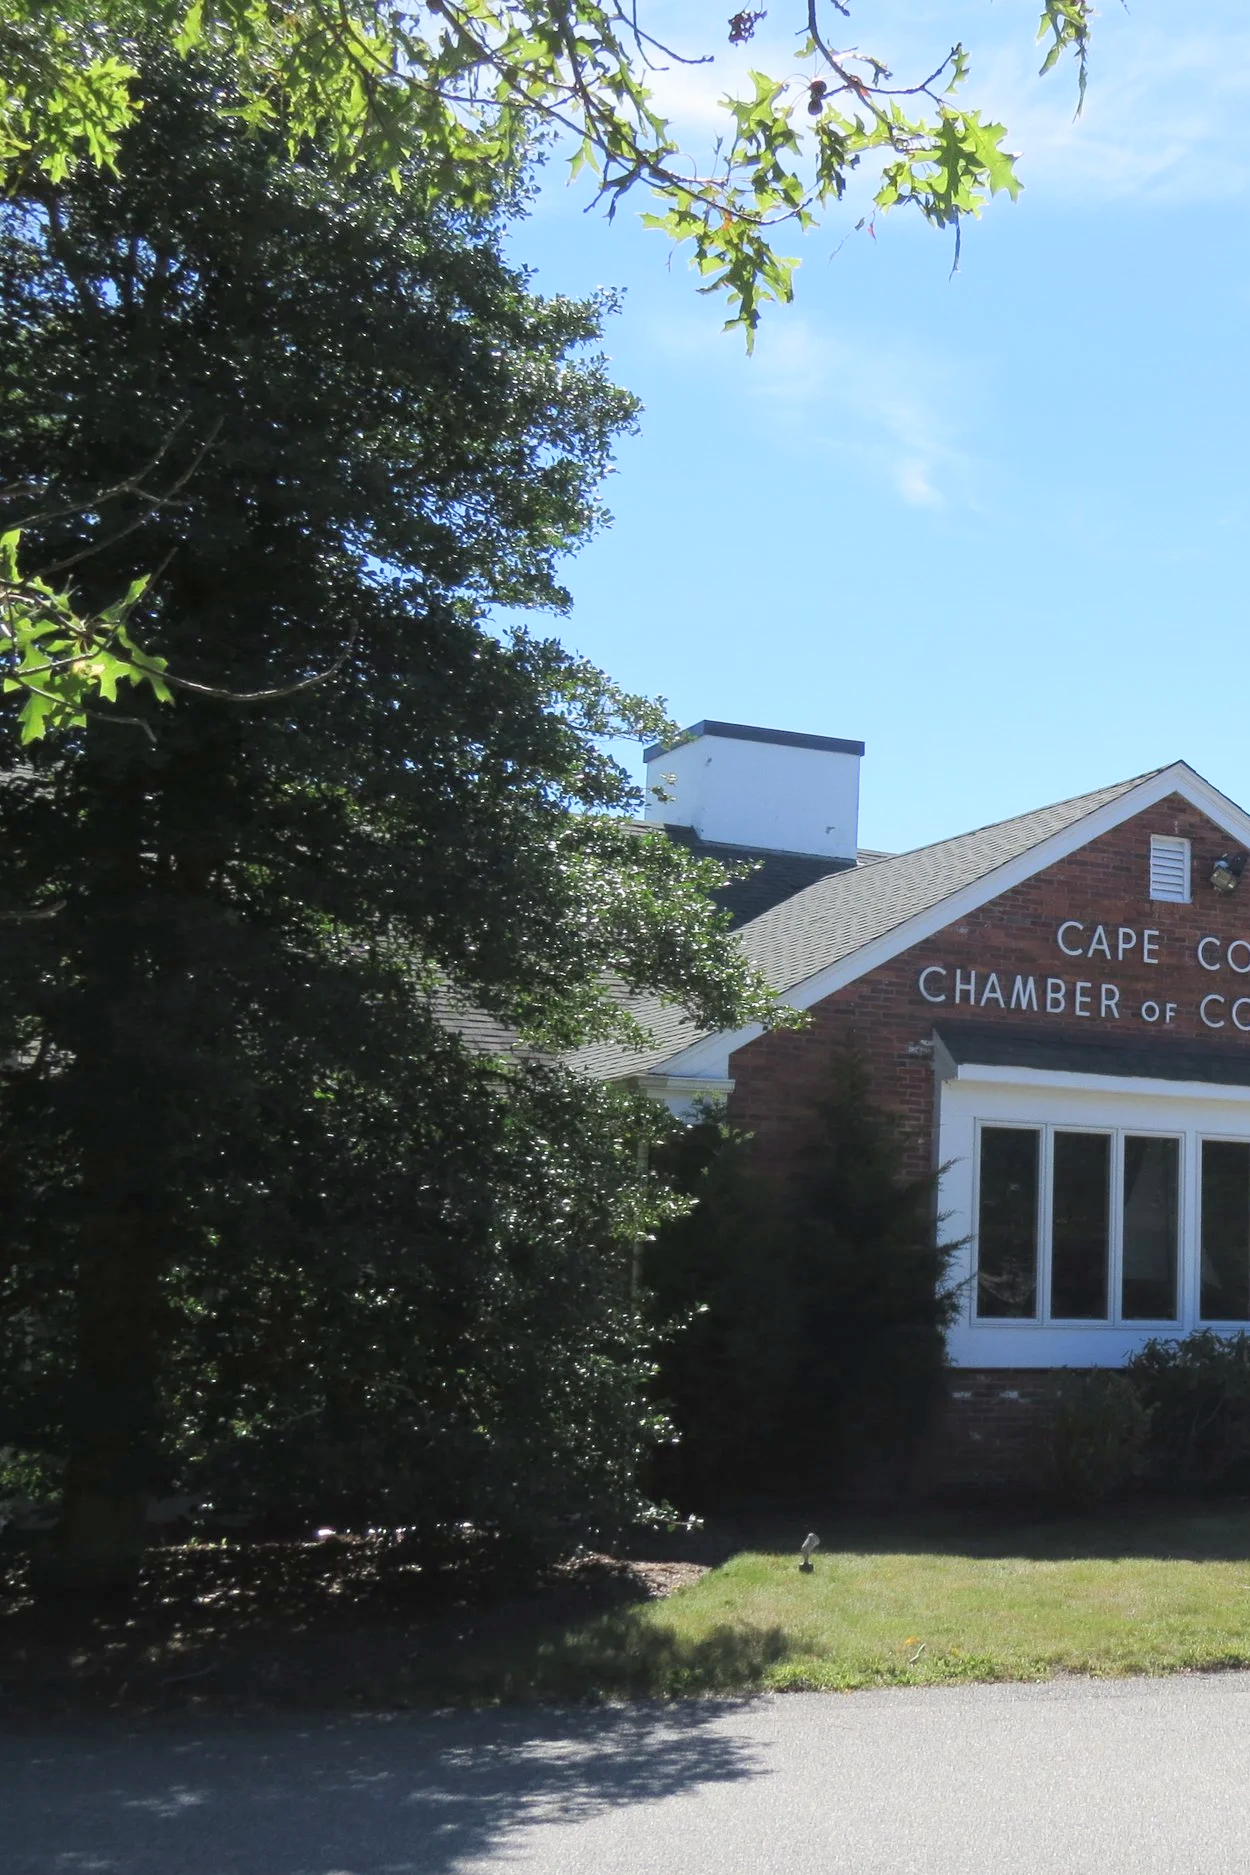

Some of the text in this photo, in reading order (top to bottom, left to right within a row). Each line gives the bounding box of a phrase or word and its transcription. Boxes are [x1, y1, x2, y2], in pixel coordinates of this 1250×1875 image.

[1056, 920, 1160, 964] CAPE
[918, 965, 1120, 1019] CHAMBER
[1140, 1000, 1178, 1024] OF
